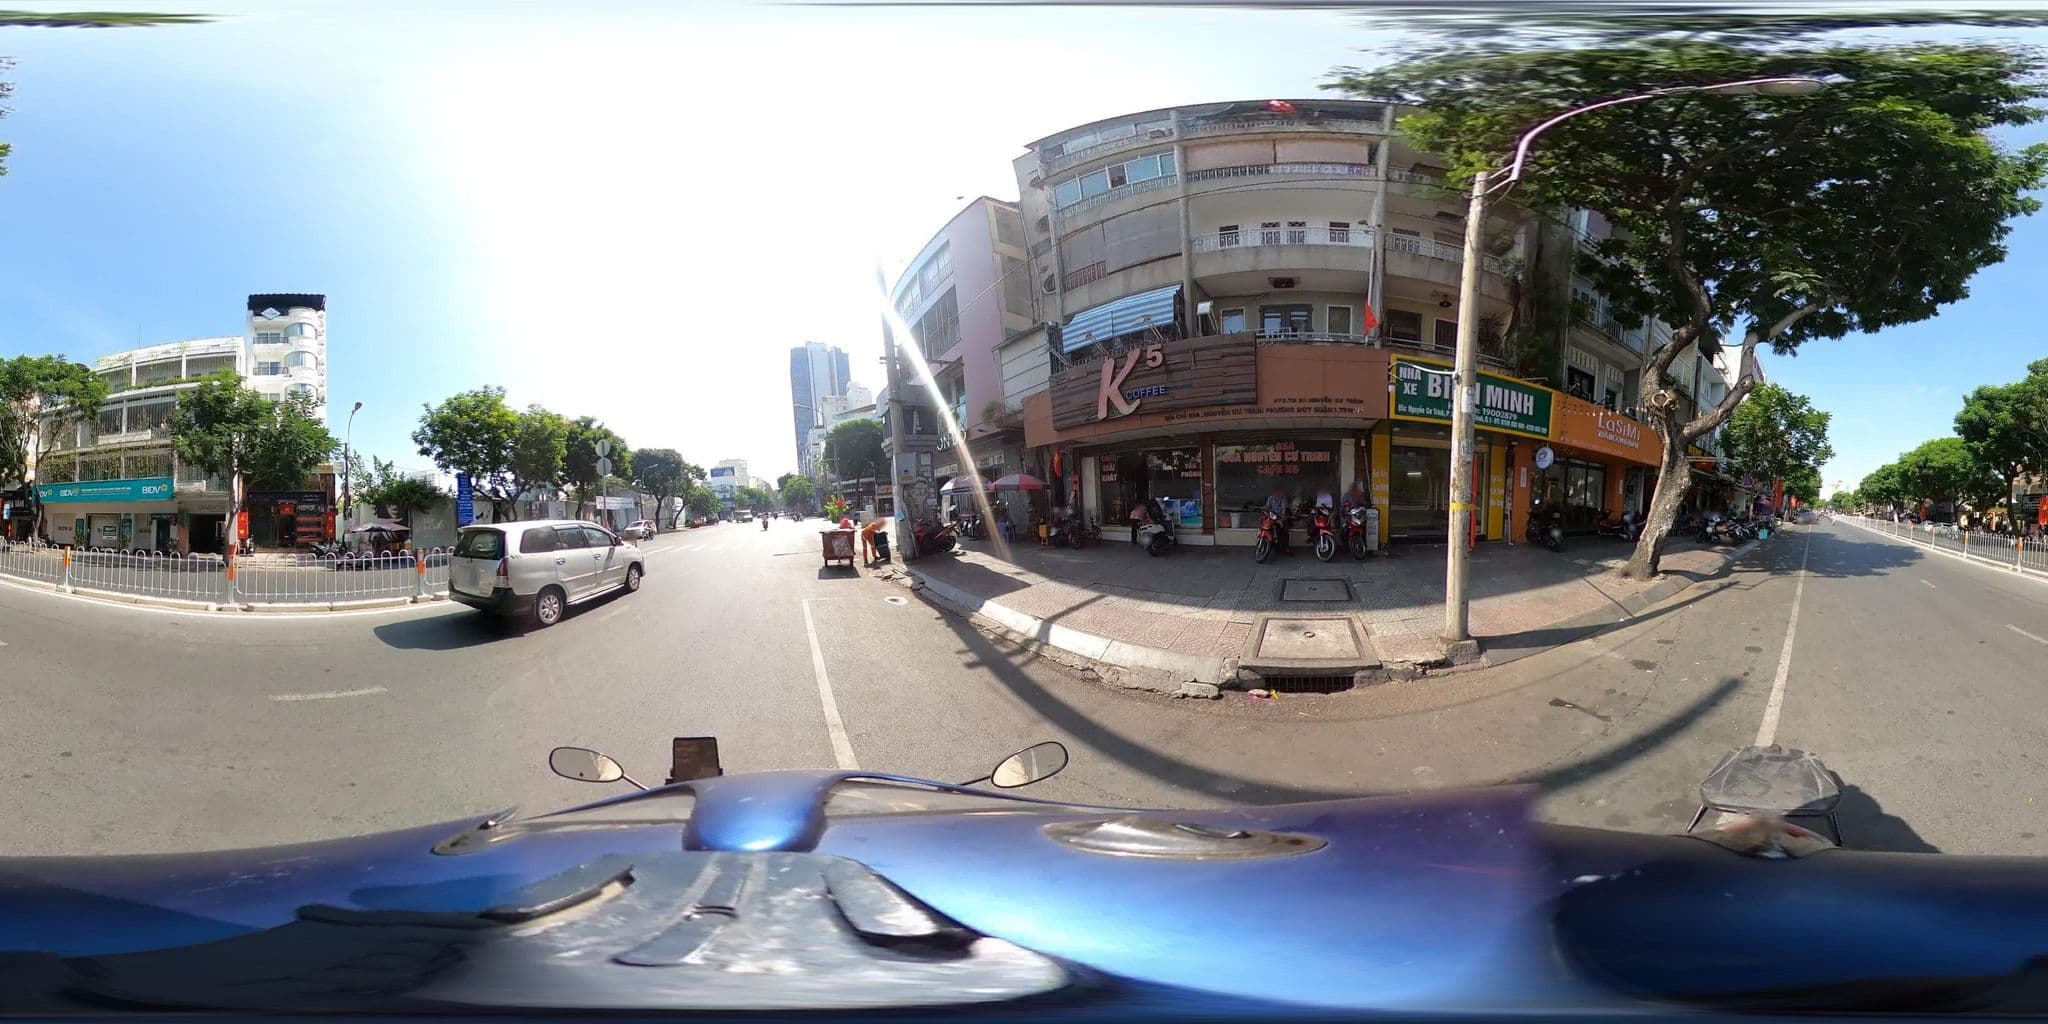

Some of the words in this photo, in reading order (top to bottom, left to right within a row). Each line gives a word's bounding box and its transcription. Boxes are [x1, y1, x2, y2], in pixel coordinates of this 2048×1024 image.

[1125, 385, 1166, 399] COFFEE
[1403, 382, 1418, 395] XE
[1486, 385, 1534, 415] MINH
[60, 489, 74, 497] BIDV
[142, 486, 160, 495] BIDV
